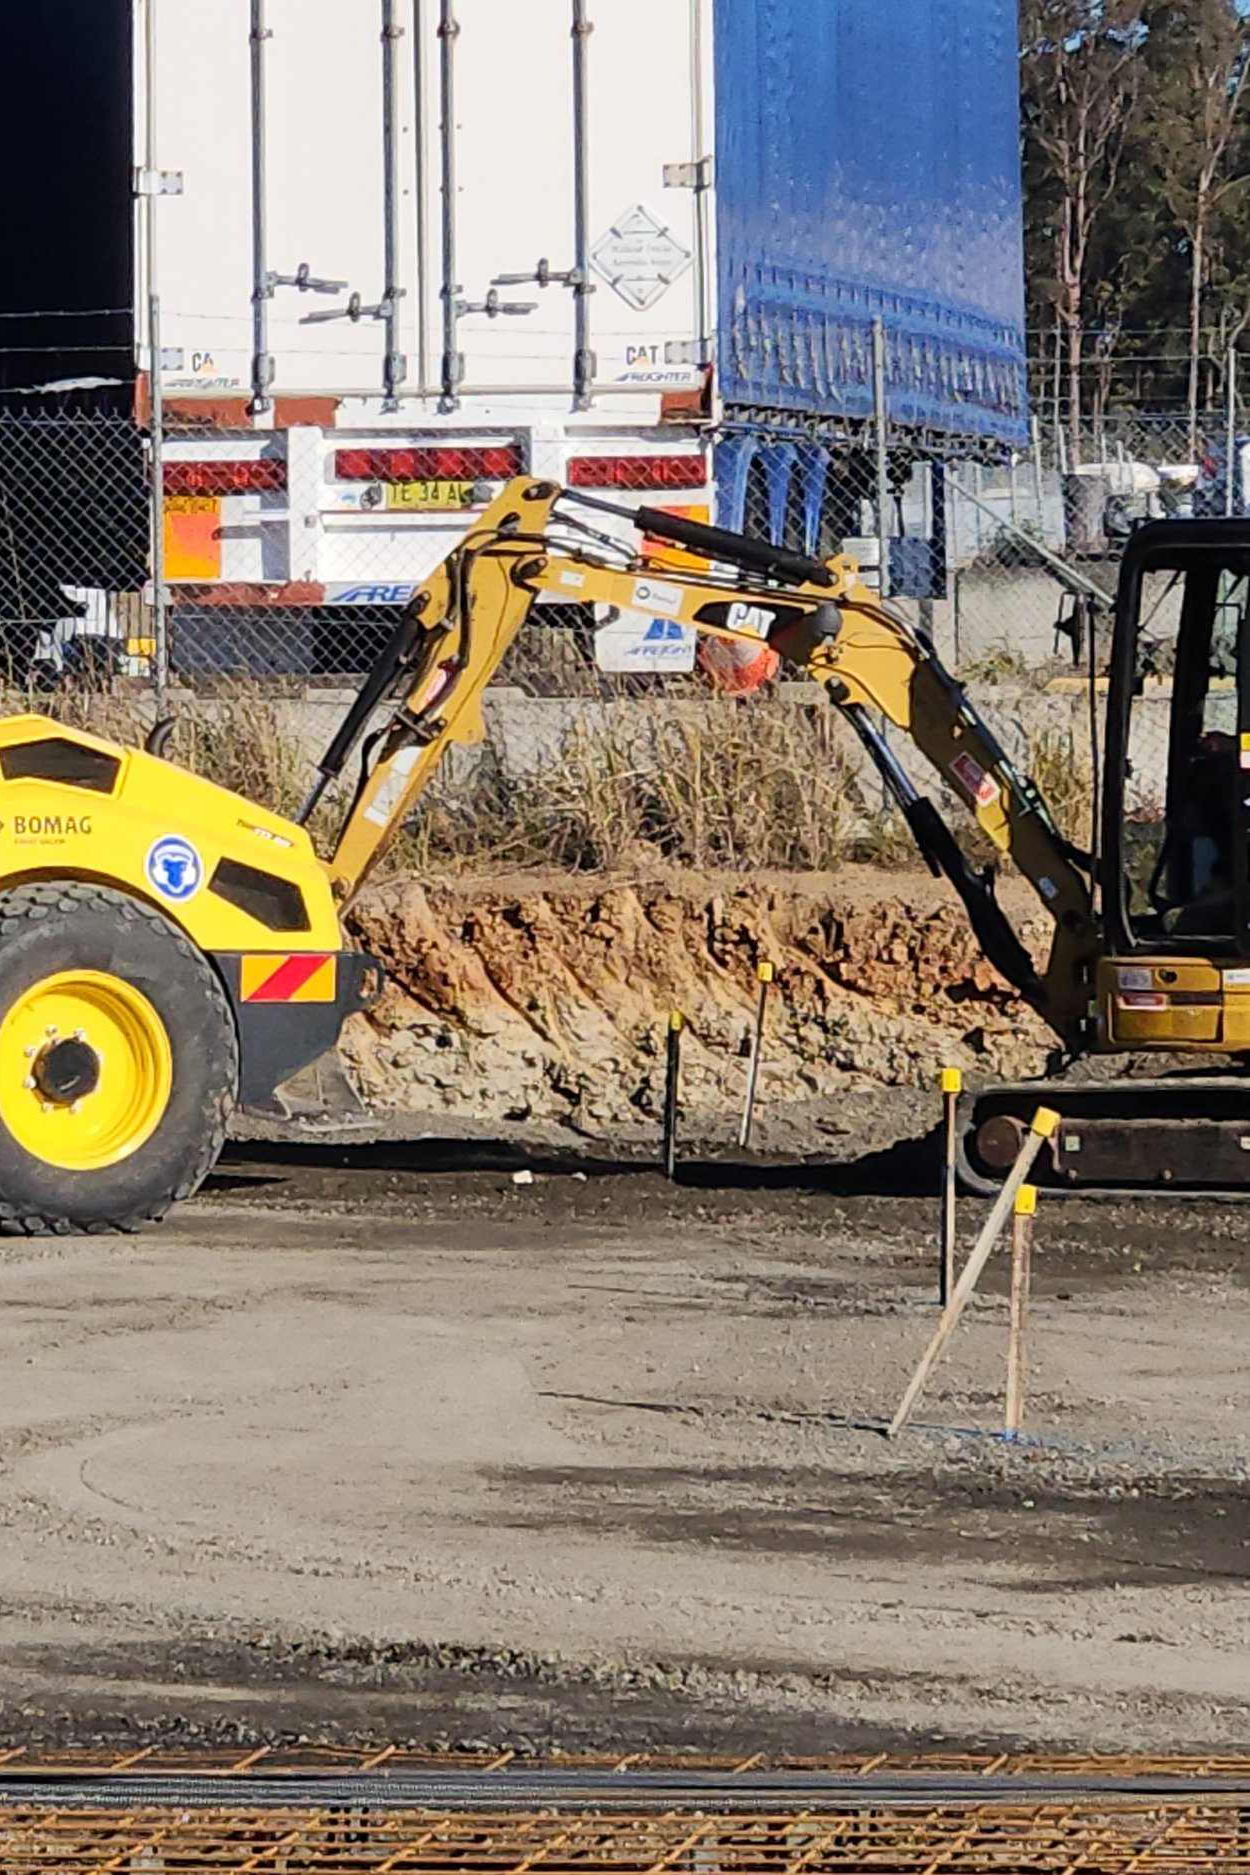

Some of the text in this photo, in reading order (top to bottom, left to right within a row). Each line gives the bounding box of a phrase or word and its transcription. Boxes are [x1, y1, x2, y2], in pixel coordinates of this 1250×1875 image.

[626, 345, 659, 366] CAT
[726, 602, 777, 639] CAT
[13, 815, 93, 835] BOMAG
